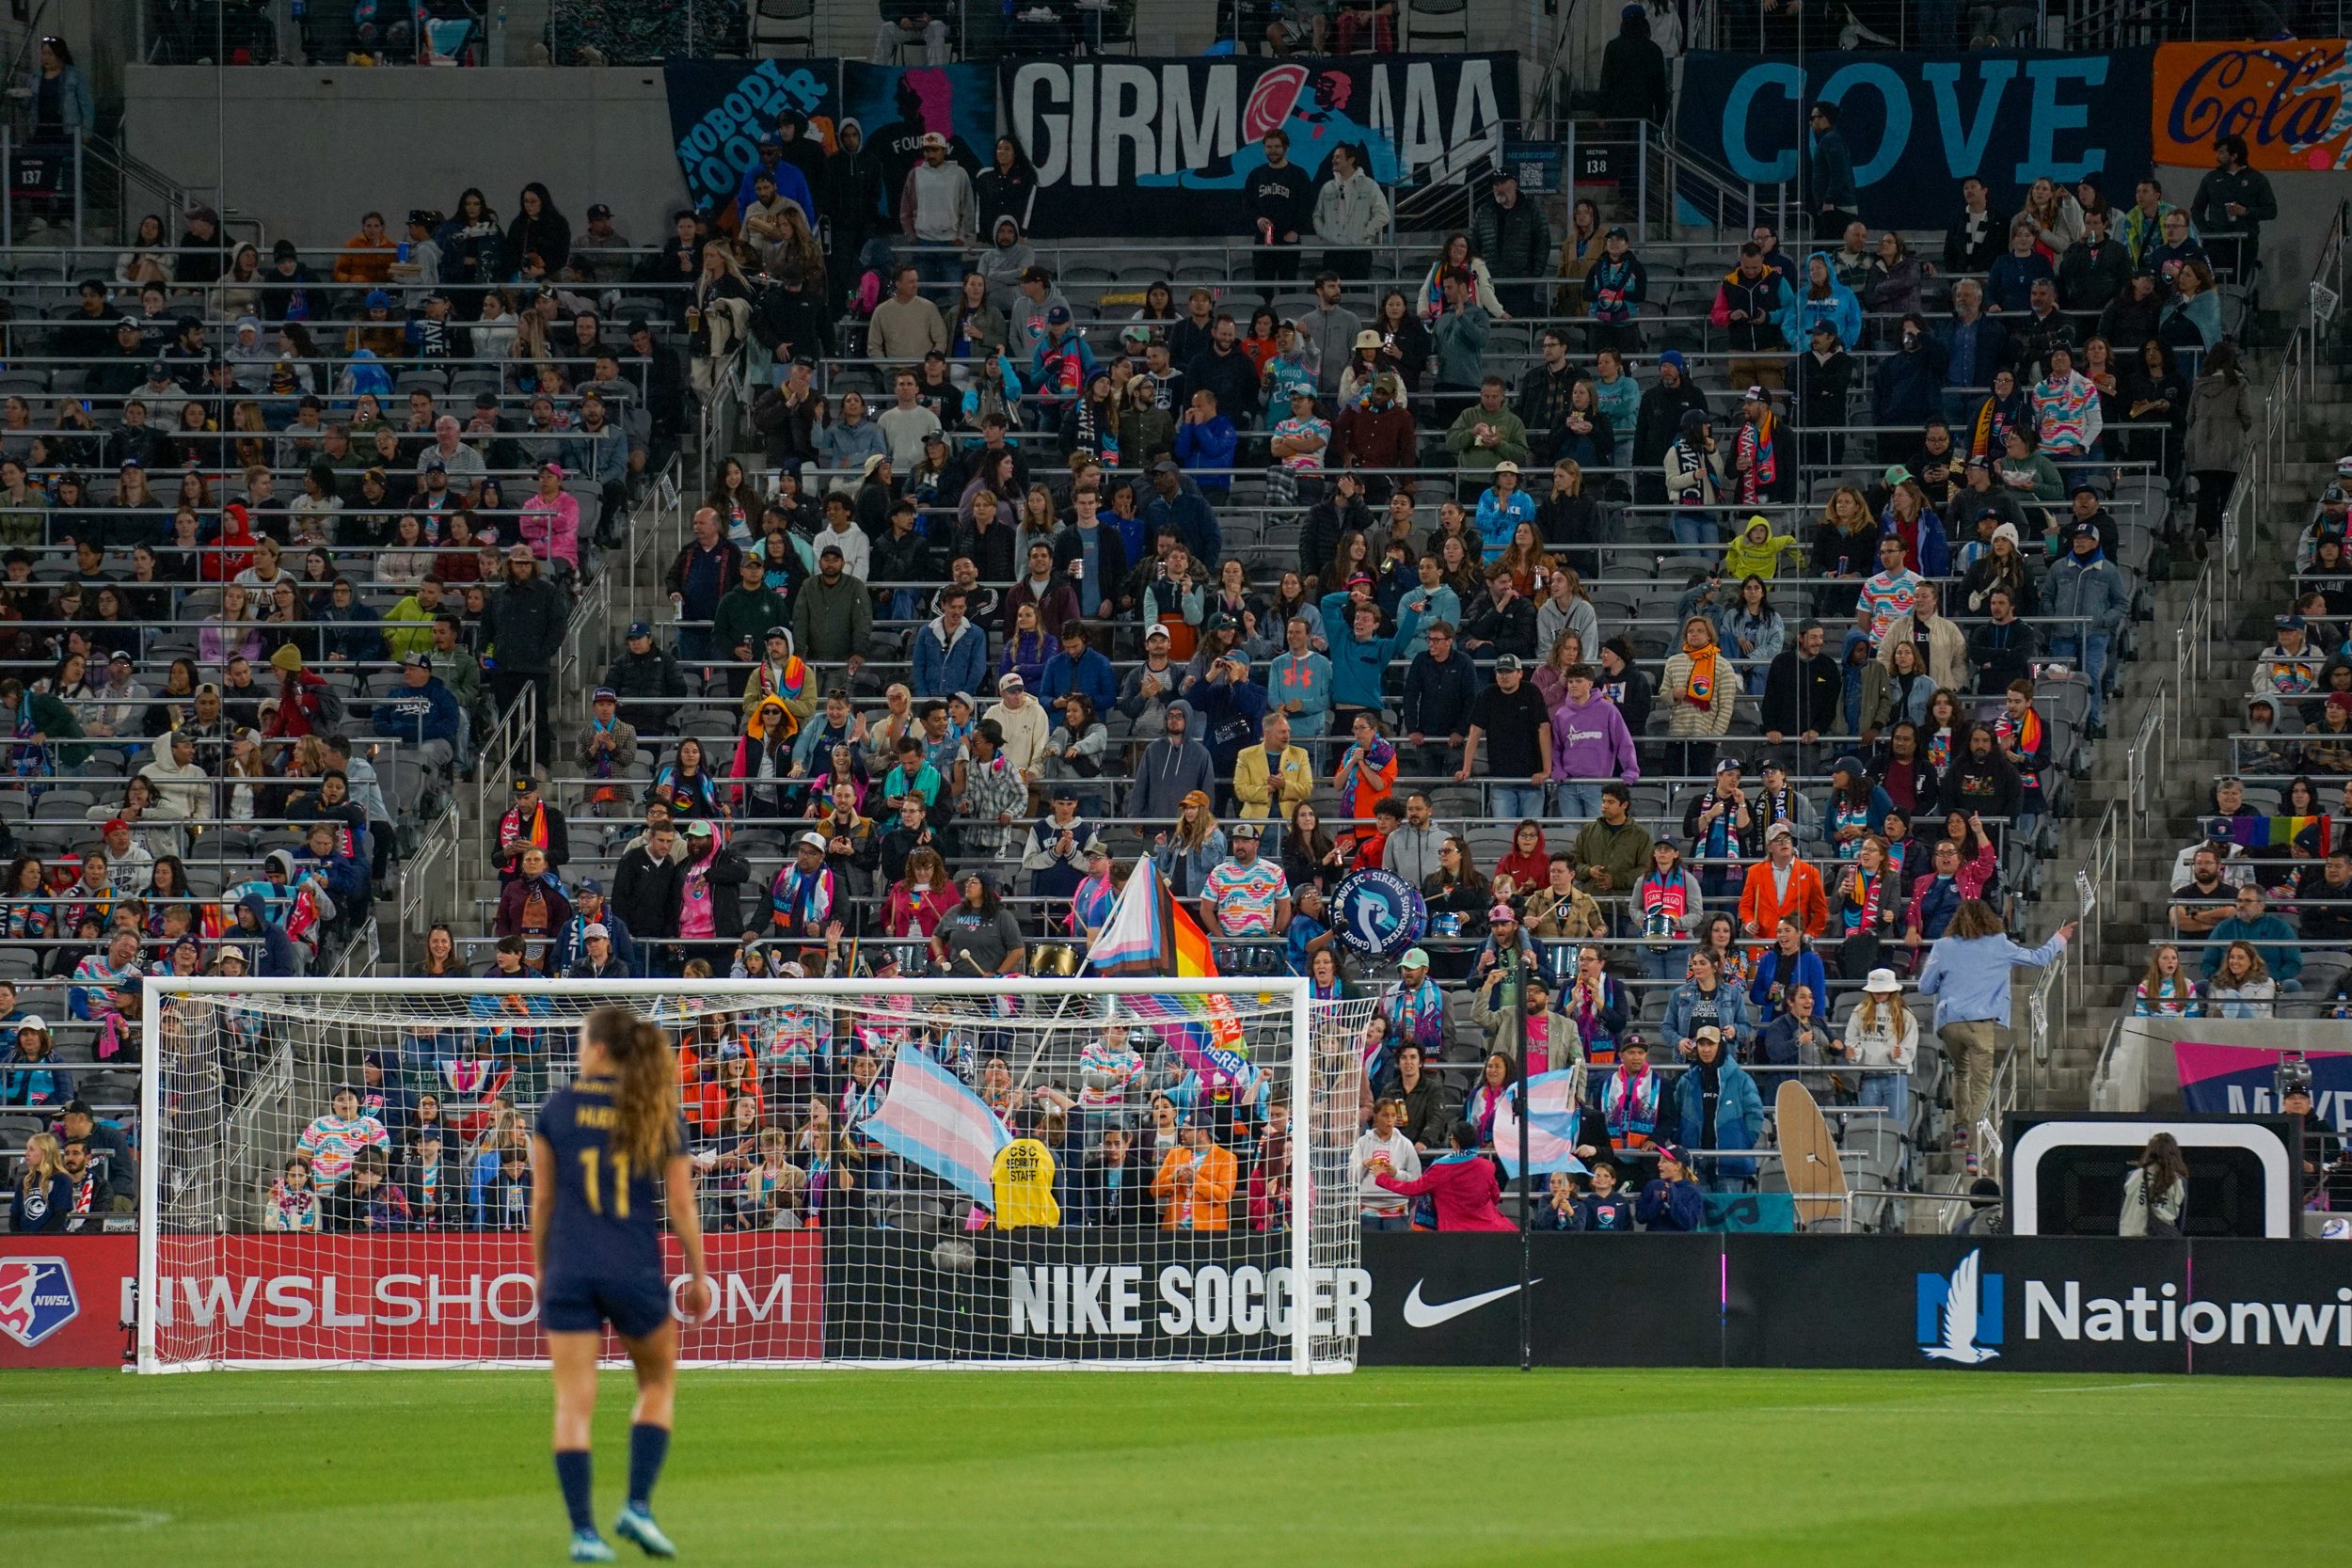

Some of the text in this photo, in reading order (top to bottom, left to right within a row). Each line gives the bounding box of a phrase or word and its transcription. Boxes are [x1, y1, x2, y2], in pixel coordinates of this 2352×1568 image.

[2168, 49, 2343, 145] Cola
[676, 58, 787, 173] NOBODY
[1722, 55, 2110, 188] COVE
[1586, 160, 1607, 174] 138
[22, 170, 42, 184] 137
[425, 320, 443, 355] AVE
[1352, 874, 1366, 886] FC
[1372, 871, 1406, 895] SIRENS
[1648, 893, 1661, 904] SAN
[956, 914, 981, 927] WAVE
[1381, 895, 1410, 947] SUPPORTERS
[1203, 1039, 1241, 1074] HERE
[1010, 1145, 1038, 1158] CSC
[1006, 1157, 1040, 1169] SECURTY
[580, 1148, 630, 1220] 11
[1010, 1170, 1037, 1182] STAFF
[34, 1295, 71, 1307] NWSL
[1010, 1265, 1373, 1337] NIKE SOCCER
